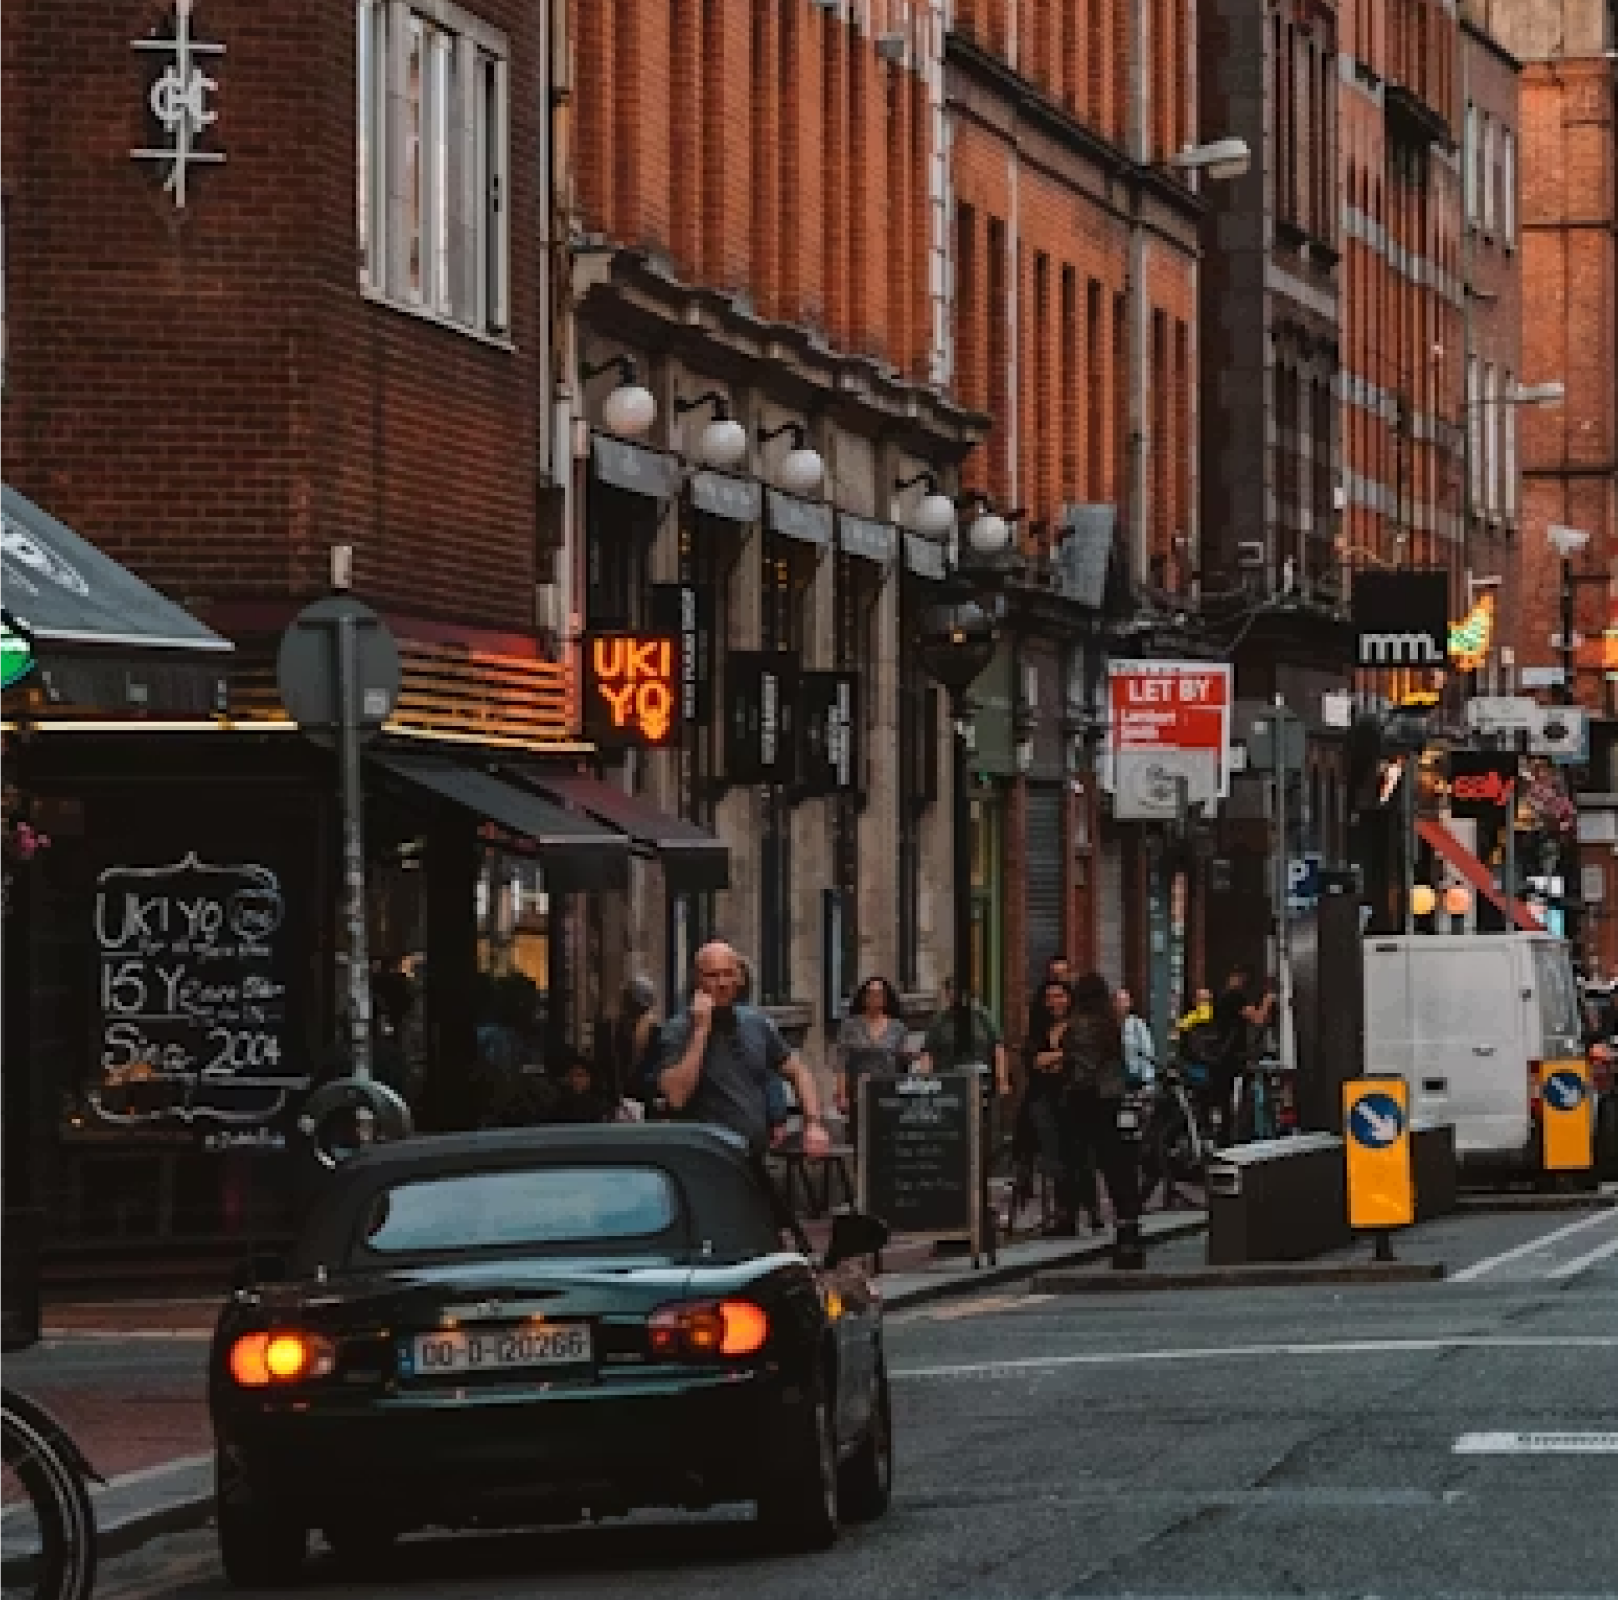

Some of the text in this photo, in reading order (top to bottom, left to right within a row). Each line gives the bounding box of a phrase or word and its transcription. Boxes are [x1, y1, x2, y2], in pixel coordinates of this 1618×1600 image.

[592, 638, 672, 678] UKI
[599, 682, 675, 741] YO
[1128, 678, 1212, 702] LET BY
[101, 961, 147, 1014] 15
[199, 1028, 282, 1075] 2004
